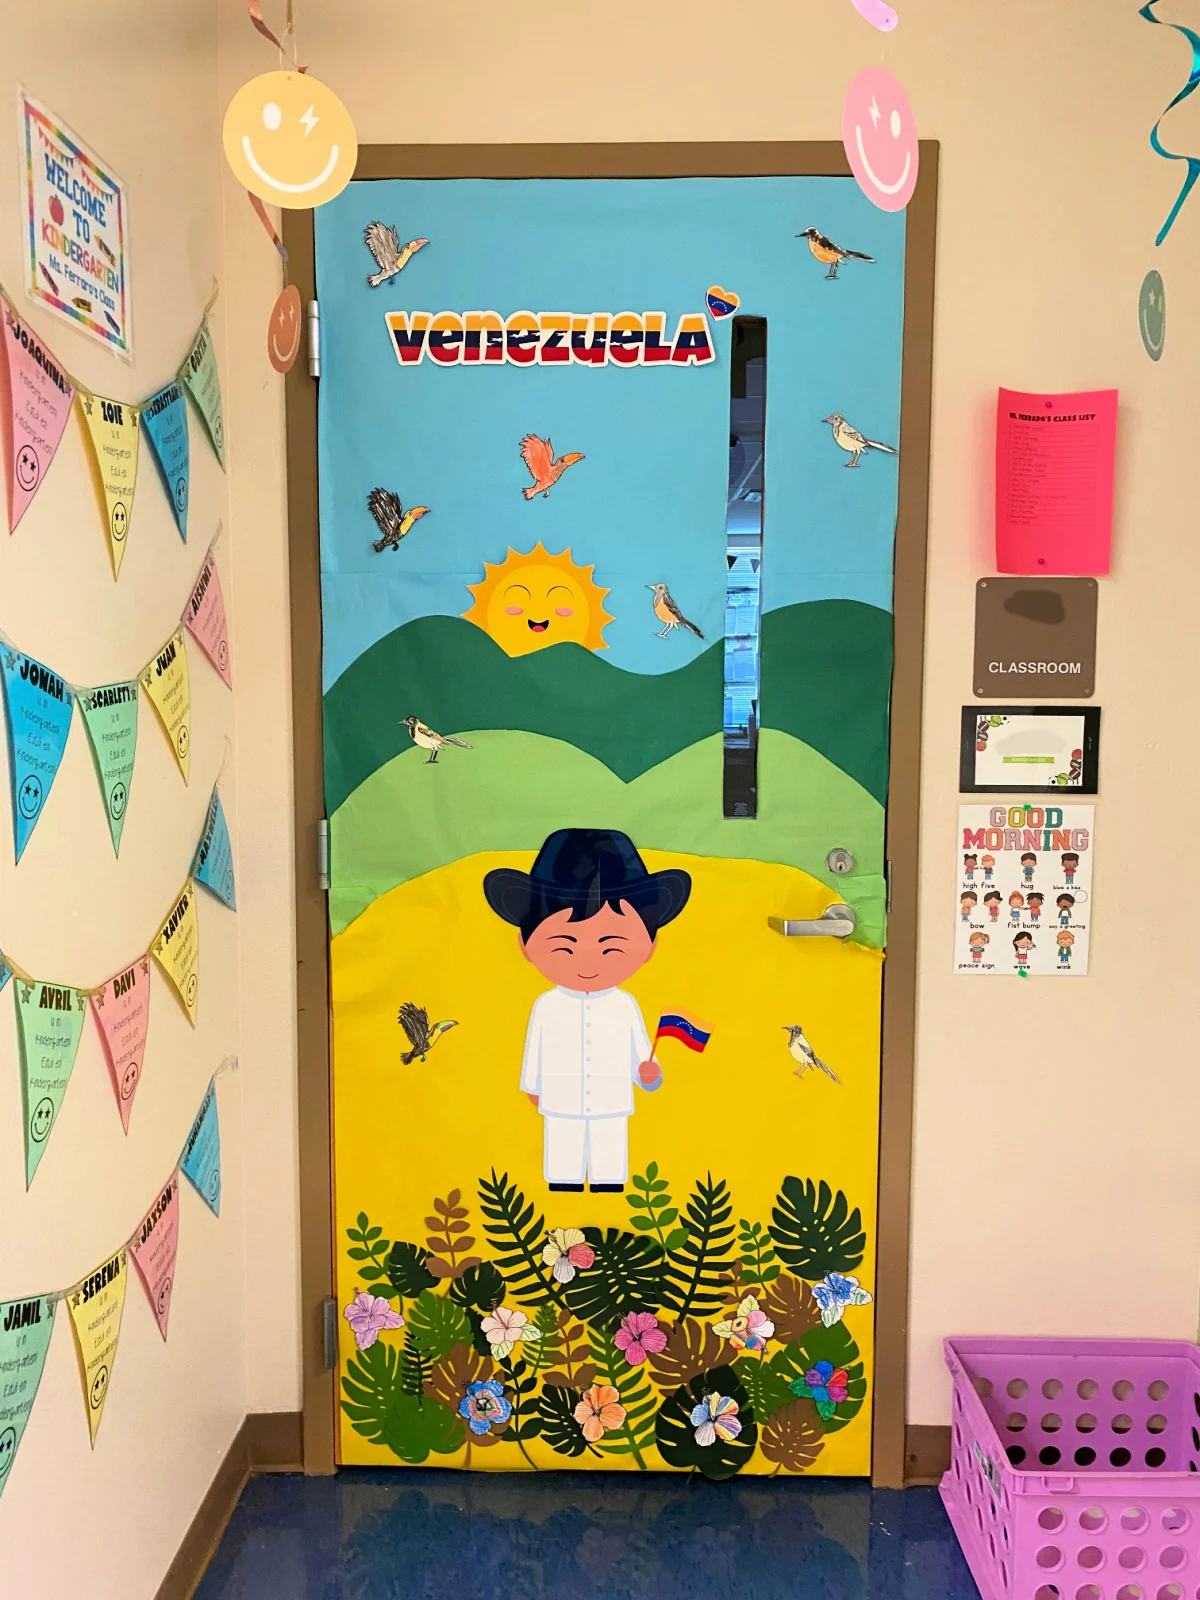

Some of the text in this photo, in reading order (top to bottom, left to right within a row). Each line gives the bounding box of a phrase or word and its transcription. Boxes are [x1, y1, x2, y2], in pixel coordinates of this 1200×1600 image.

[44, 153, 106, 227] WELCOME
[72, 211, 90, 243] TO
[42, 218, 119, 294] KINDERGARTEN
[49, 253, 63, 276] Ms.
[99, 287, 115, 311] Class
[12, 323, 65, 394] JOAQUINA
[101, 401, 123, 426] ZOIE
[1079, 413, 1096, 421] LIST
[156, 640, 176, 677] JUAN
[988, 662, 1081, 674] CLASSROOM
[20, 659, 64, 703] JONAH
[91, 686, 130, 709] SCARLETT
[990, 807, 1063, 828] GOOD
[963, 828, 1089, 851] MORNING
[962, 882, 996, 891] high five
[1020, 882, 1034, 891] hug
[163, 894, 189, 945] XAVIER
[970, 922, 985, 930] bow
[1007, 921, 1041, 931] fist bump
[958, 961, 995, 971] peace sign
[113, 968, 136, 999] DAVI
[39, 985, 72, 1011] AVRIL
[141, 1184, 172, 1243] JAXSON
[83, 1256, 120, 1304] SERENA
[4, 1299, 41, 1332] JAMIL
